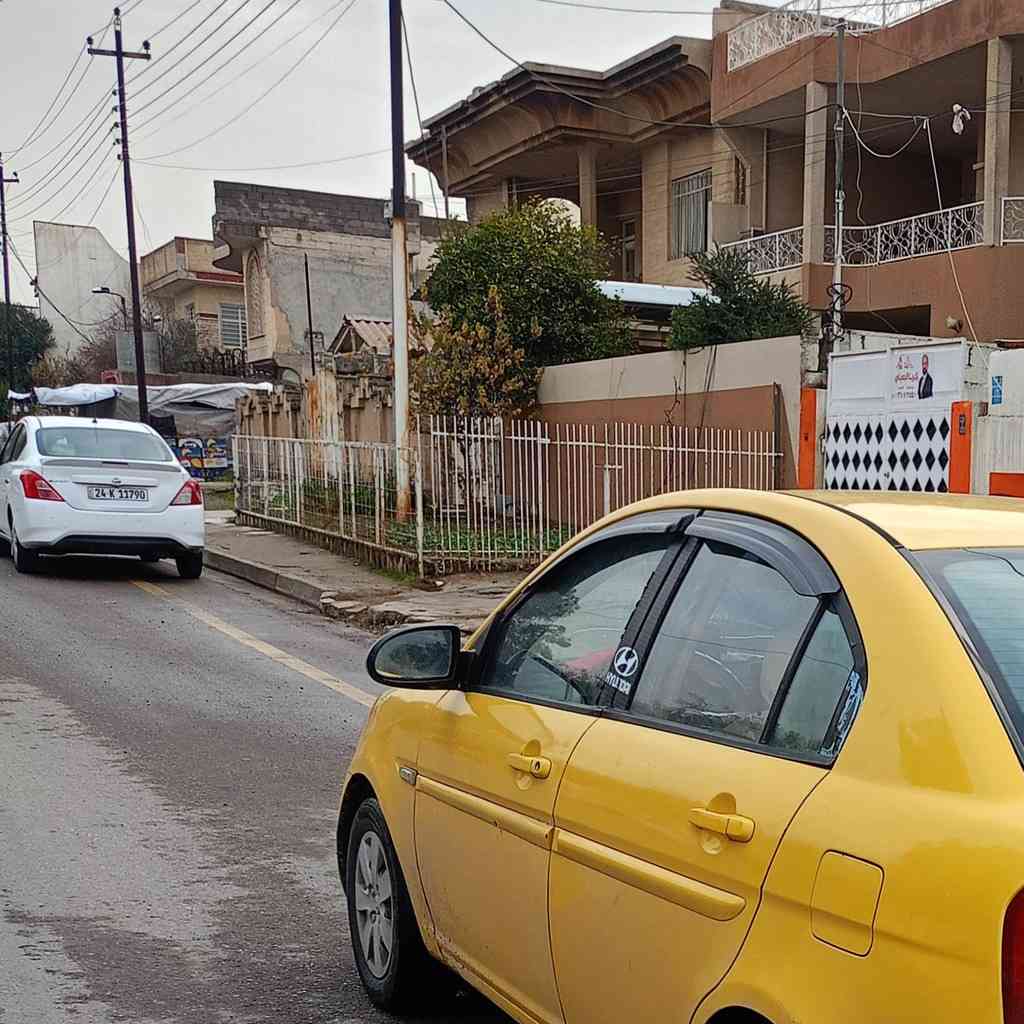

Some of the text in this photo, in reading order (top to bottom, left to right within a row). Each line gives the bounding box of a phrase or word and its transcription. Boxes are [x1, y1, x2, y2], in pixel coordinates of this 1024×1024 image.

[95, 488, 146, 500] 24 K 11790
